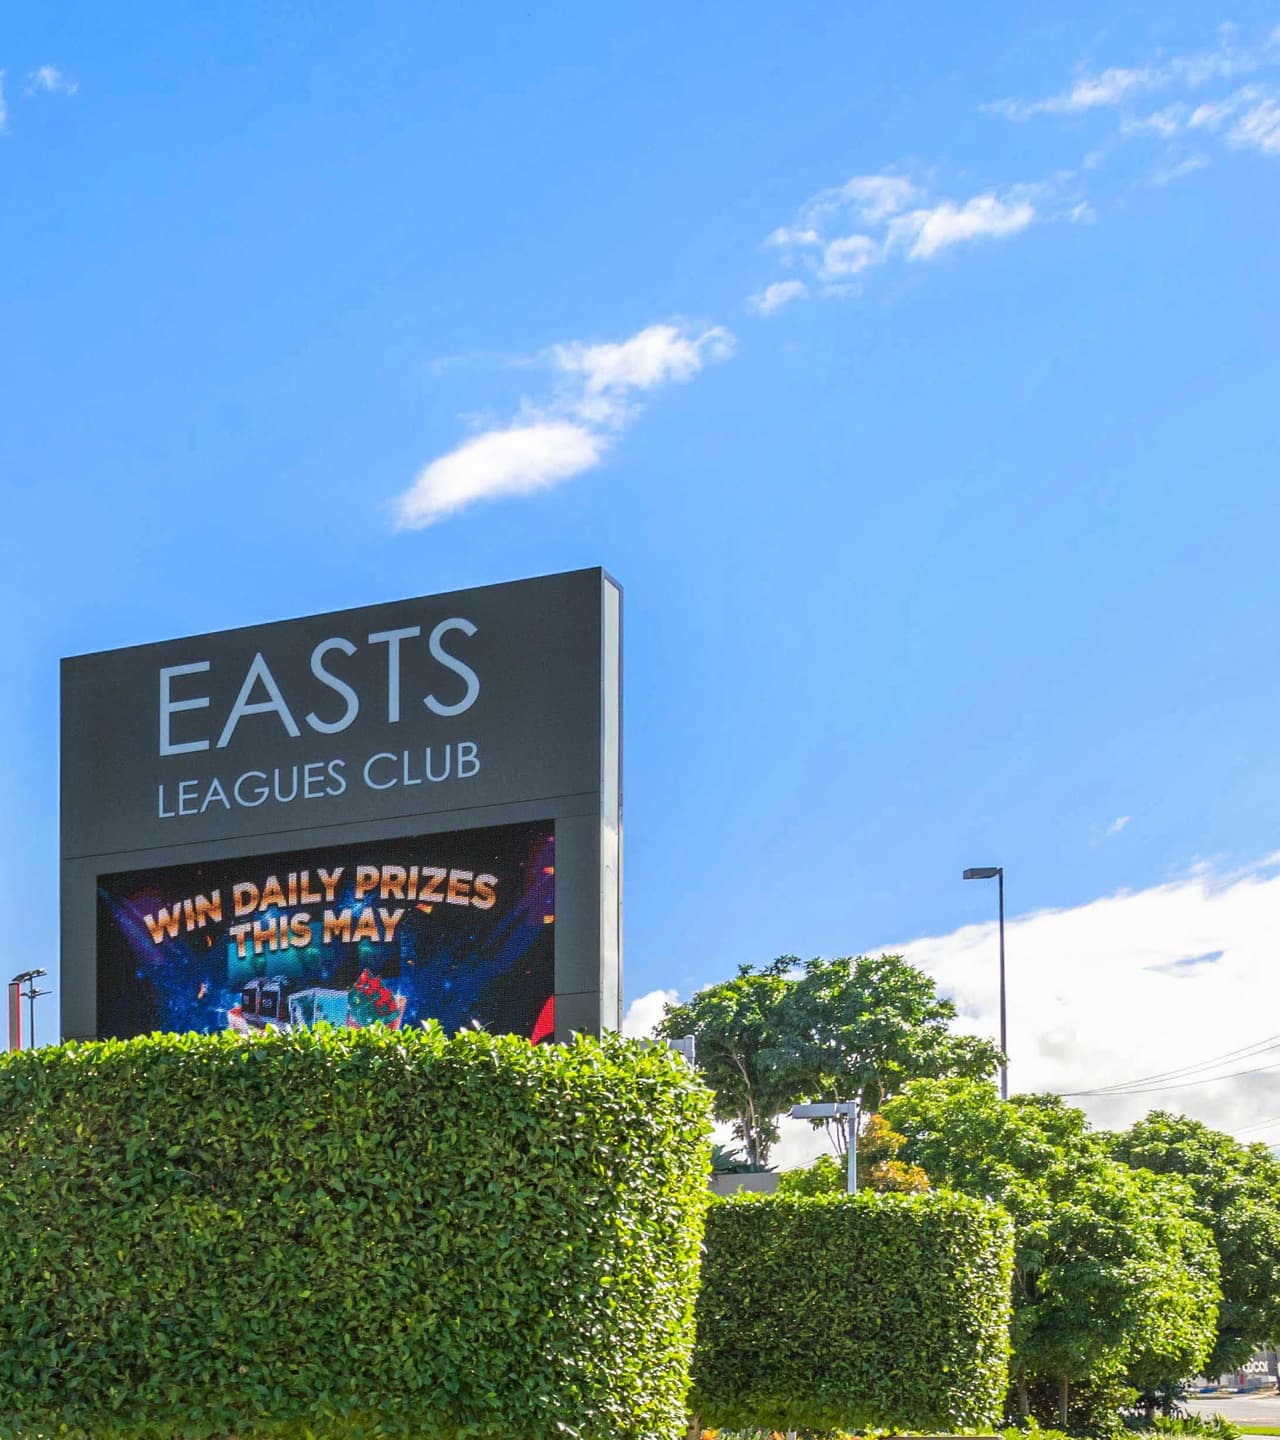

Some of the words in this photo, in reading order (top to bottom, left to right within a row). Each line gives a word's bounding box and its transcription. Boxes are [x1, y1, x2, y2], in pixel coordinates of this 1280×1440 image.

[158, 617, 481, 757] EASTS
[157, 758, 346, 819] LEAGUES
[362, 741, 481, 791] CLUB
[143, 888, 223, 945] WIN
[231, 866, 345, 917] DAILY
[354, 864, 499, 910] PRIZES
[229, 912, 312, 959] THIS
[323, 907, 406, 943] MAY
